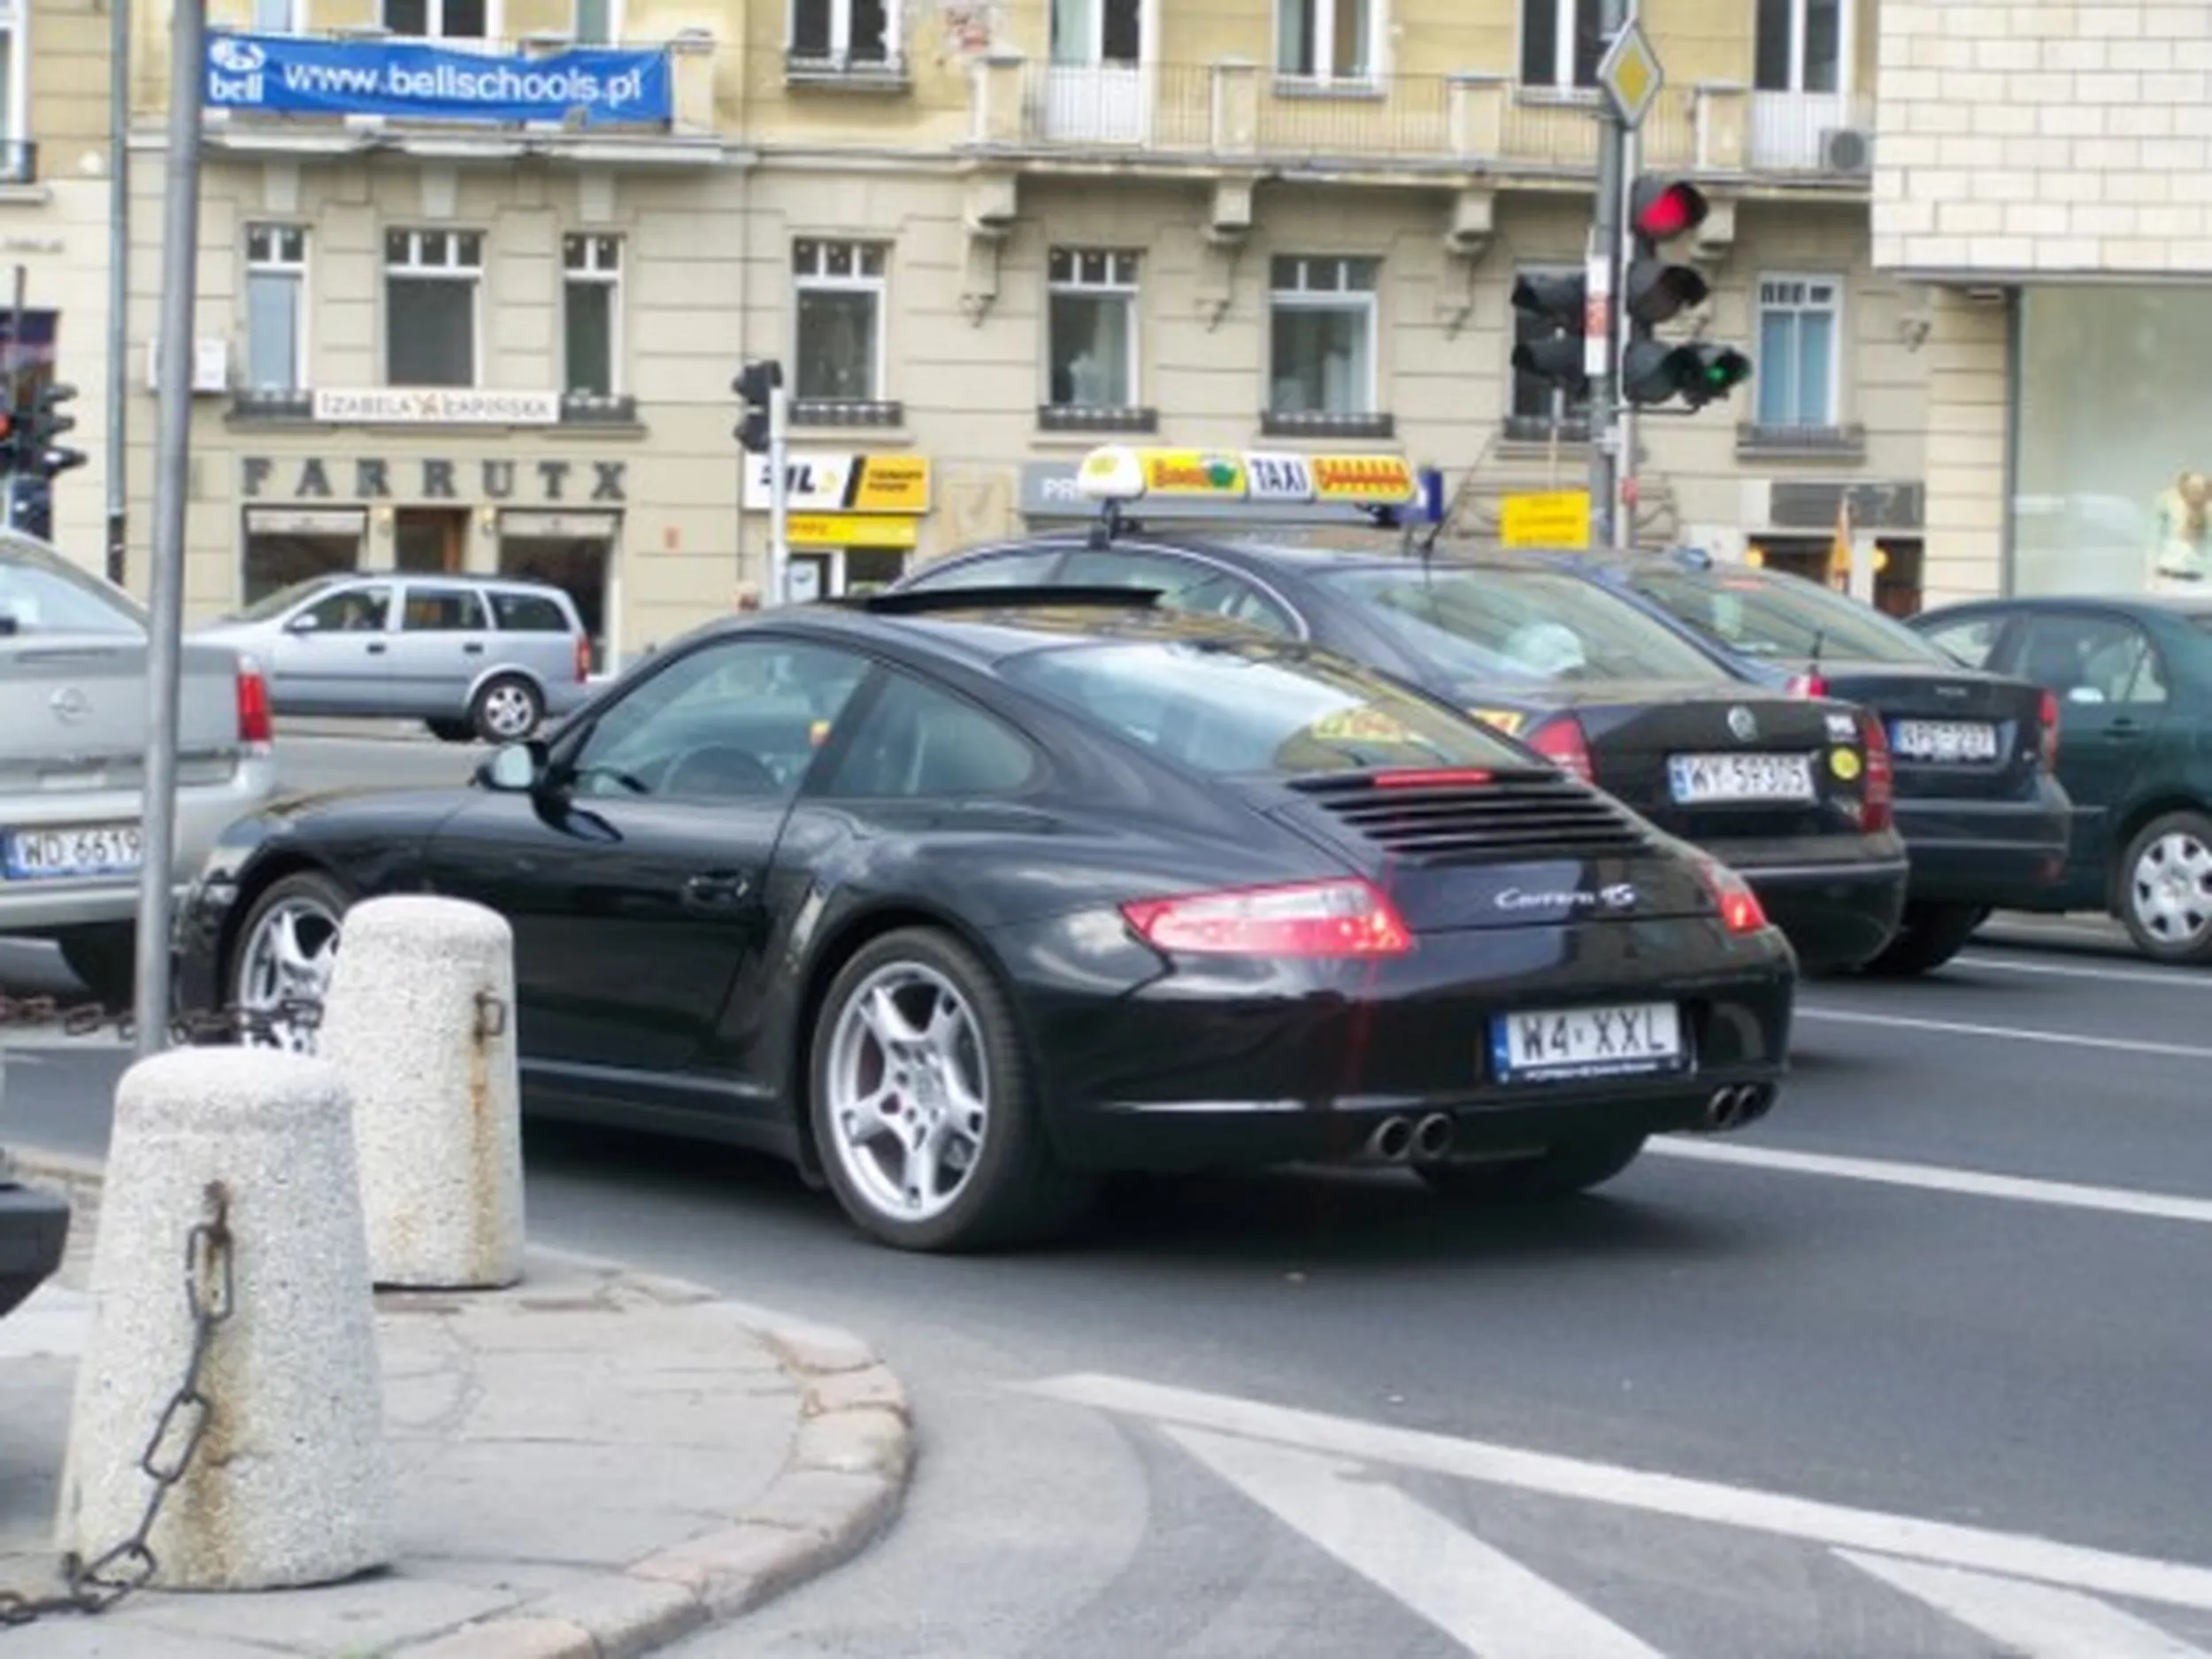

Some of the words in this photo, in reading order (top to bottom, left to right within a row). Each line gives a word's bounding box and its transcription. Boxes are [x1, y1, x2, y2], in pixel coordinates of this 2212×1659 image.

[210, 70, 264, 104] bell
[283, 63, 641, 108] www.bellschools.pl
[321, 391, 411, 415] IZABELA
[242, 457, 626, 500] FARRUTX
[1250, 457, 1309, 492] TAXI
[1494, 887, 1595, 910] Carrera
[1520, 1014, 1570, 1061] W4
[1593, 1006, 1665, 1055] XXL
